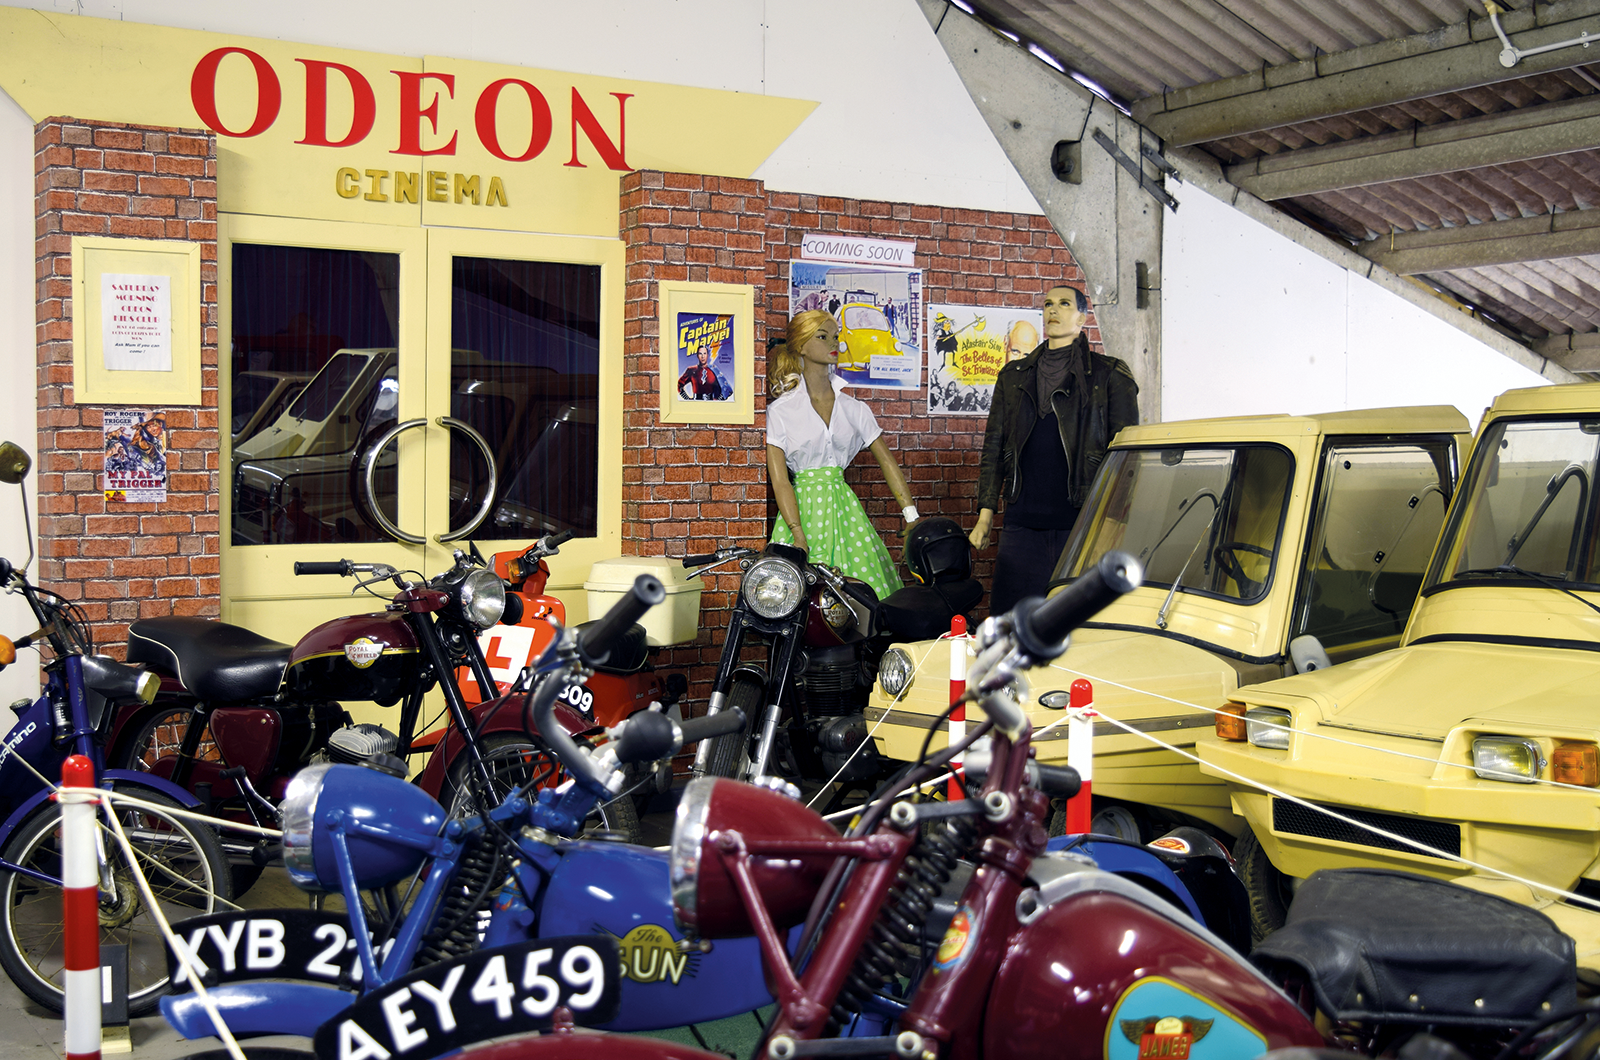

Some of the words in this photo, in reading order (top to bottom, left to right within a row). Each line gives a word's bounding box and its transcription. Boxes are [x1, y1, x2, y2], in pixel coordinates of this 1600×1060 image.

[190, 46, 636, 172] ODEON
[335, 167, 509, 207] CINEMA
[806, 240, 864, 257] COMING
[866, 246, 904, 261] SOON
[111, 284, 160, 292] SATURDAY
[121, 305, 153, 313] ODEON
[679, 319, 727, 348] Captain
[687, 327, 730, 356] Marvel
[961, 338, 988, 353] Alastair
[960, 353, 972, 365] The
[972, 350, 995, 364] Belles
[995, 356, 1003, 367] of
[107, 470, 127, 479] MY
[130, 470, 153, 479] PAL
[109, 479, 163, 488] TRIGGER
[485, 636, 512, 670] L
[631, 928, 664, 943] The
[173, 918, 286, 984] XYB
[619, 945, 688, 985] UN
[1141, 1036, 1188, 1058] JAMES
